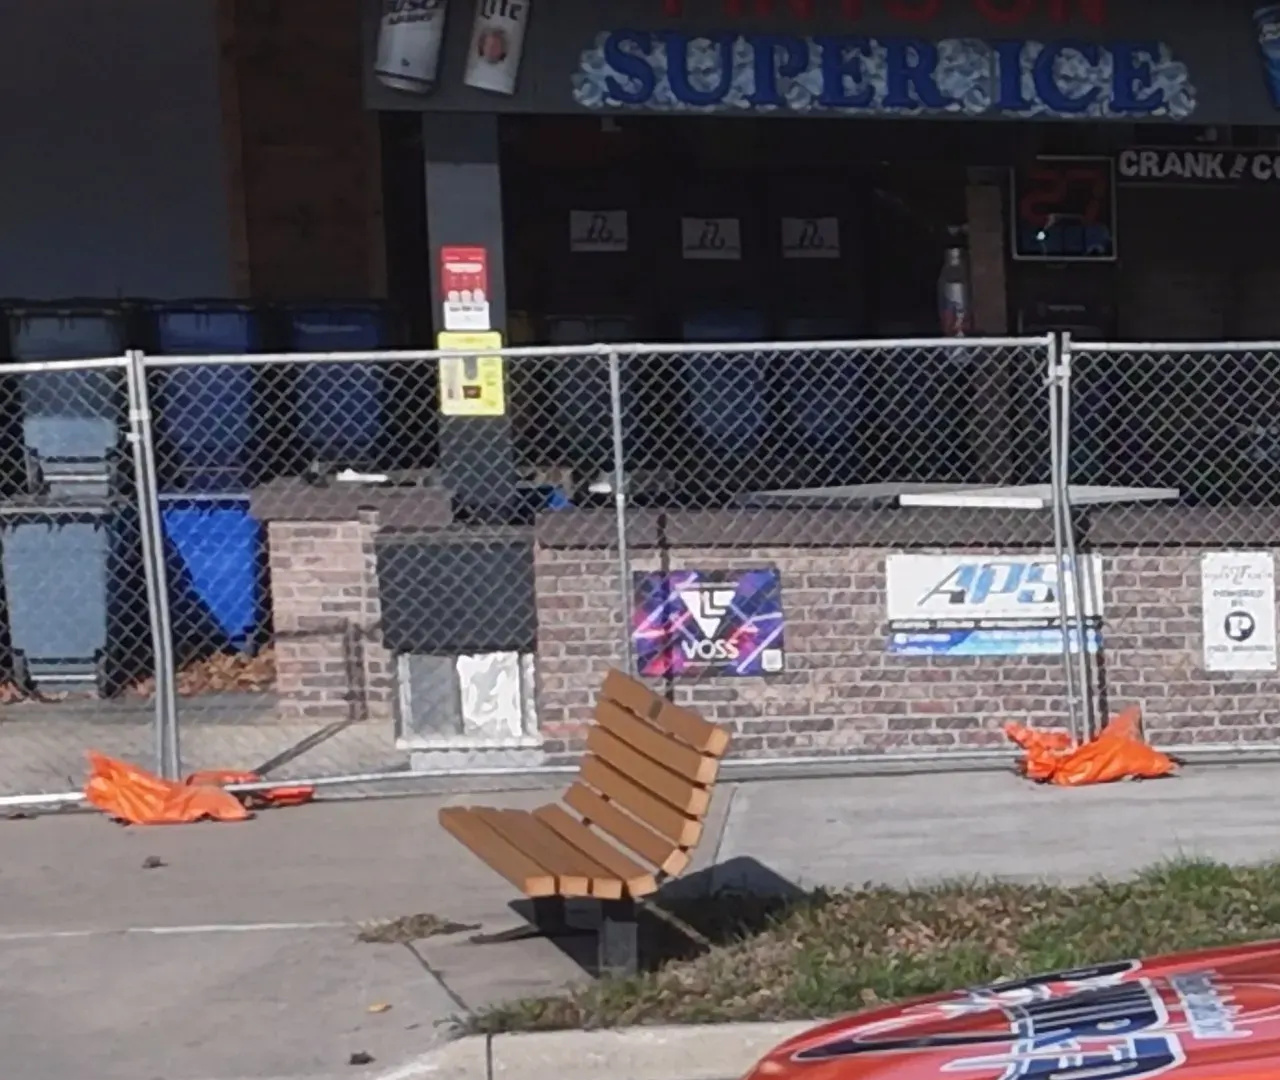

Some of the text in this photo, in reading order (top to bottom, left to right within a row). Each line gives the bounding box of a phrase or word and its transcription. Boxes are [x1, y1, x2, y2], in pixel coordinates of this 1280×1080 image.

[603, 28, 1166, 112] SUPER ICE
[1118, 150, 1225, 179] CRANK
[681, 639, 740, 660] VOSS
